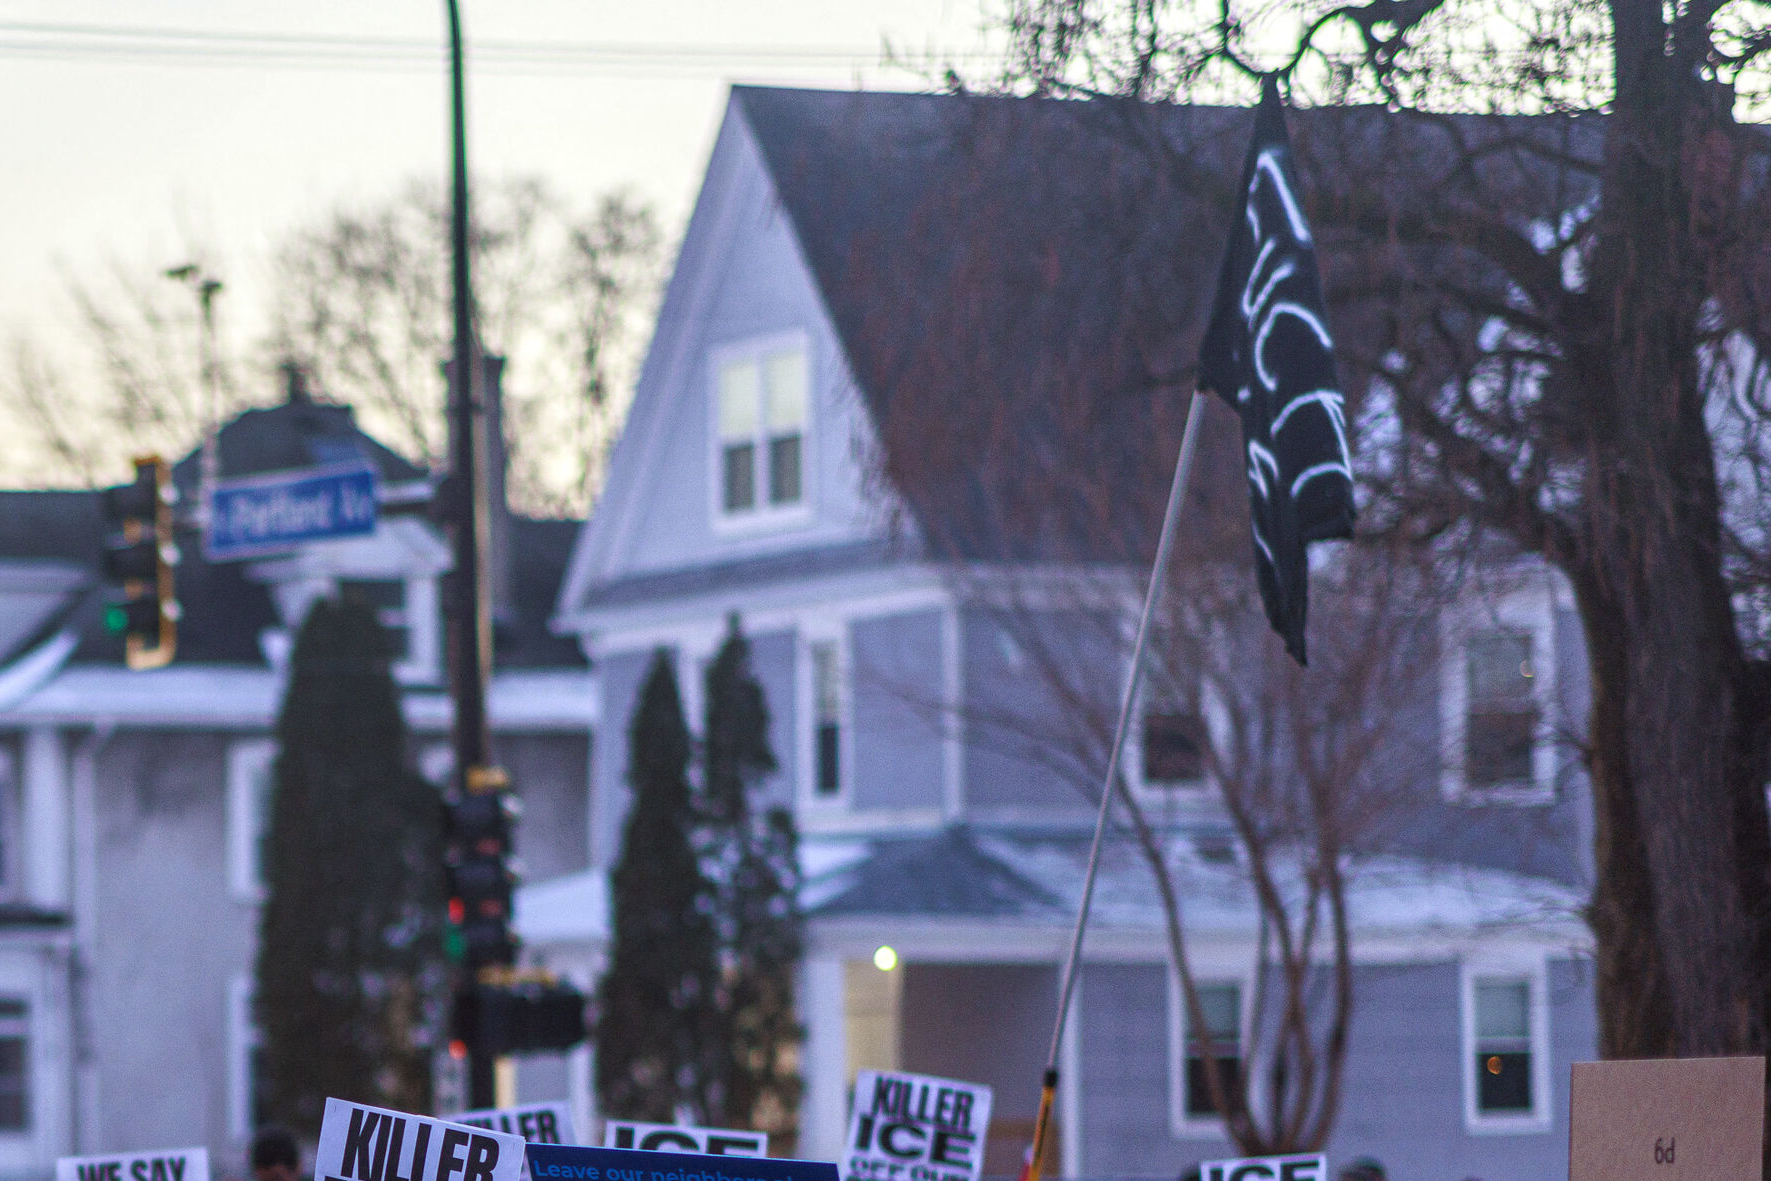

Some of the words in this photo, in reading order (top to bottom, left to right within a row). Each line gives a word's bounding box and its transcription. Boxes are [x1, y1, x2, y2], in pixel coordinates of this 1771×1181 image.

[871, 1076, 974, 1129] KILLER
[855, 1114, 977, 1169] ICE
[1654, 1137, 1675, 1165] 6d
[533, 1159, 600, 1181] Leave
[850, 1156, 904, 1176] OFF
